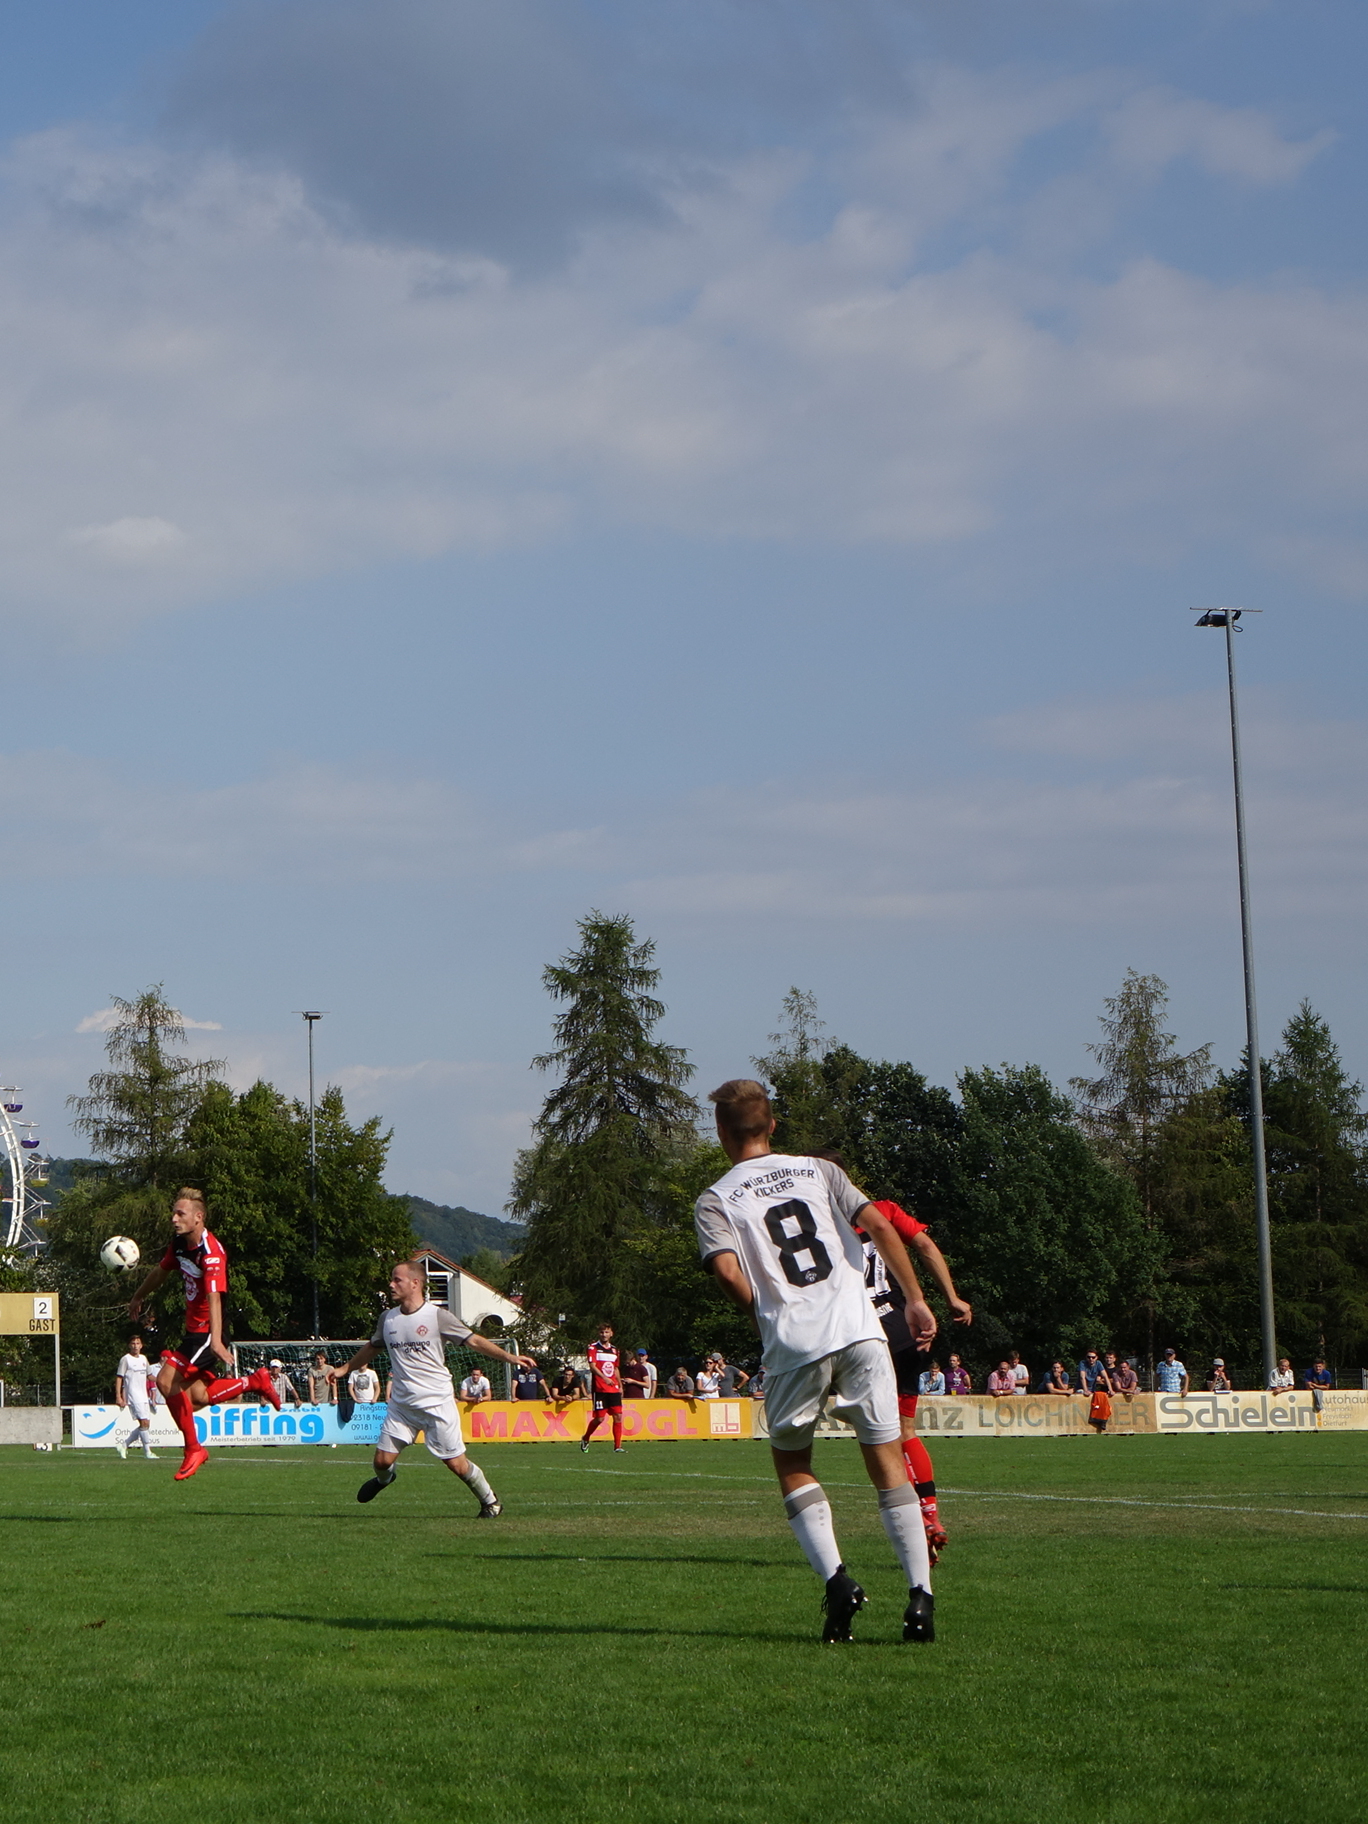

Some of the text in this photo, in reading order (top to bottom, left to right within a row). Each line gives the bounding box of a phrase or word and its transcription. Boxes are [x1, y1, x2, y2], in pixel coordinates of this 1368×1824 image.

[729, 1168, 815, 1202] FC WÜRZBURGER
[753, 1178, 795, 1198] KICKERS
[764, 1199, 833, 1288] 8
[38, 1302, 48, 1314] 2
[29, 1319, 56, 1332] GAST
[404, 1345, 427, 1354] druck
[595, 1400, 604, 1410] 11
[1323, 1394, 1368, 1404] utohau
[359, 1404, 388, 1412] Ringstra
[979, 1400, 1150, 1427] LOICHINER
[1159, 1394, 1317, 1428] Schielein
[471, 1411, 570, 1438] MAX
